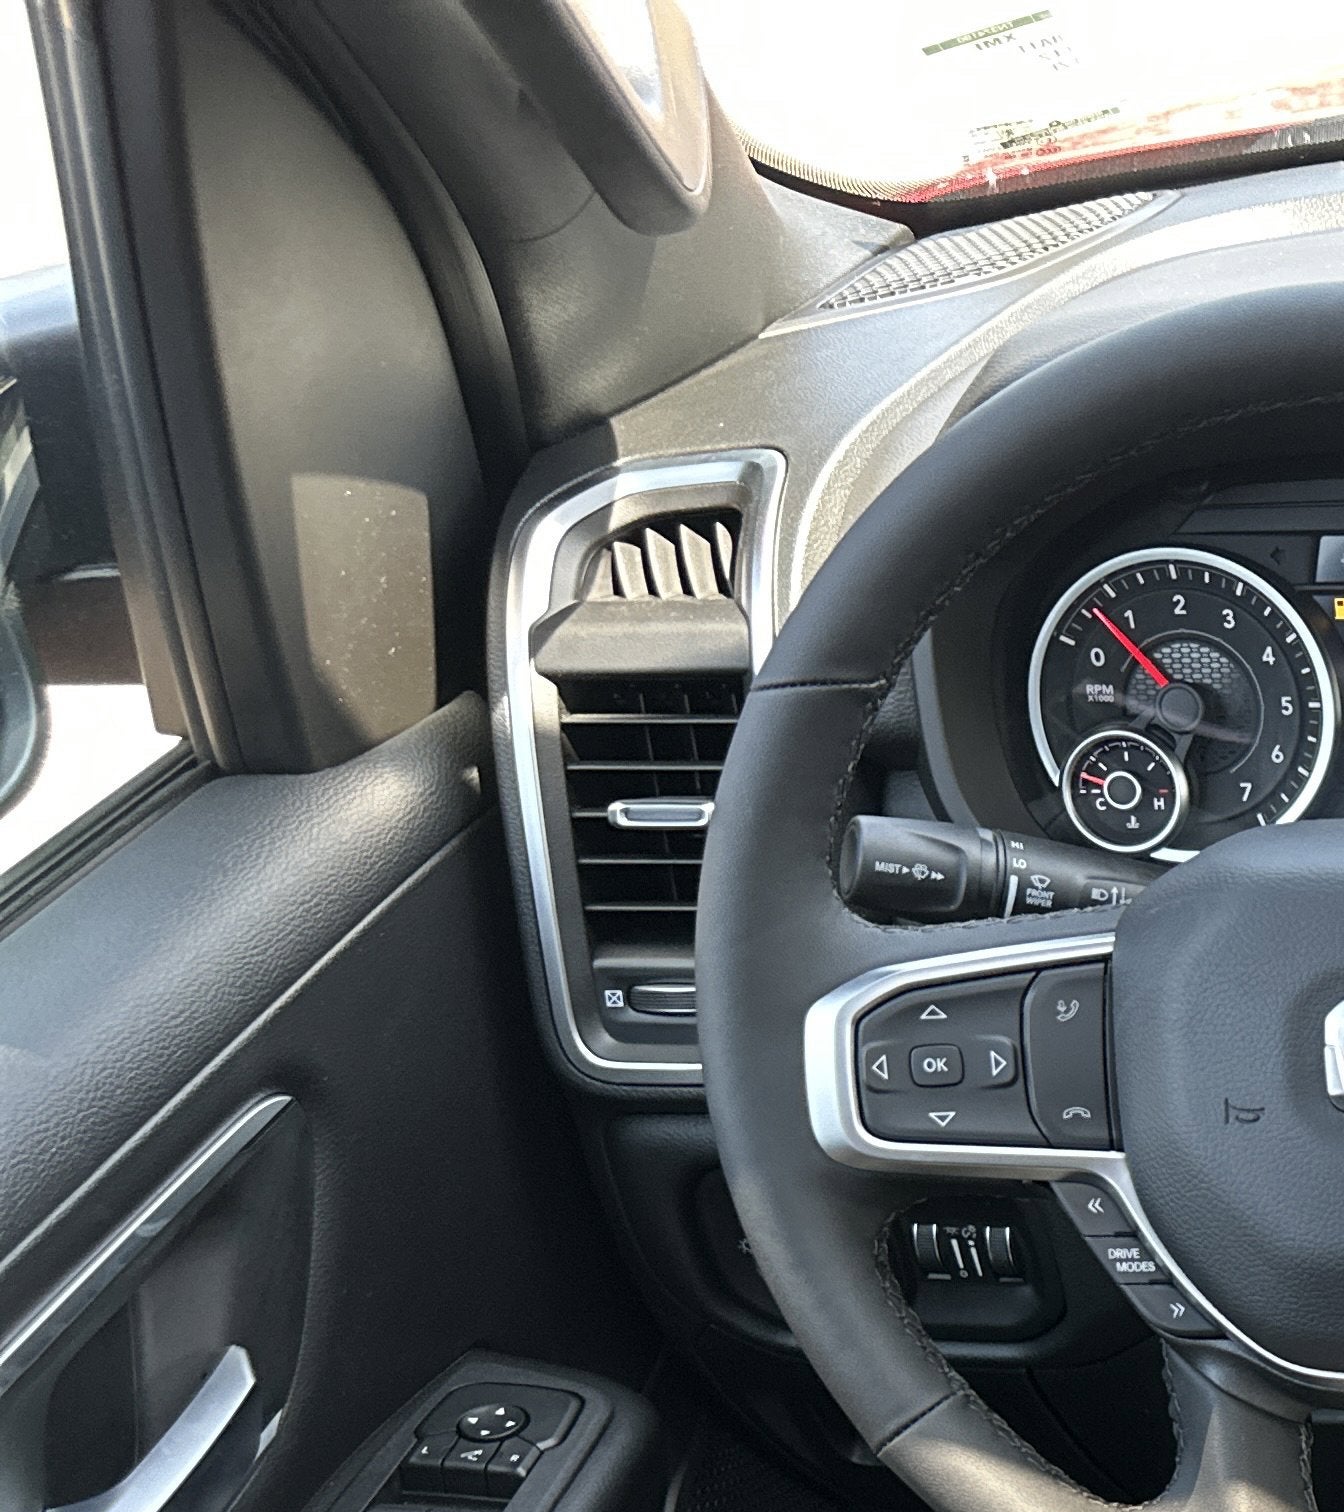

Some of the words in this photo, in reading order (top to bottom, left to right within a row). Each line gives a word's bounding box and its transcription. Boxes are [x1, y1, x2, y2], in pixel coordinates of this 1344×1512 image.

[1172, 594, 1187, 615] 2
[1124, 609, 1136, 629] 1
[1222, 608, 1236, 630] 3
[1090, 647, 1105, 667] 0
[1261, 646, 1275, 666] 4
[1086, 684, 1114, 696] RPM
[1281, 696, 1294, 716] 5
[1271, 744, 1285, 764] 6
[1239, 782, 1253, 802] 7
[1095, 798, 1107, 811] C
[1154, 798, 1165, 810] H
[875, 861, 903, 875] MIST
[1012, 858, 1027, 869] LO
[1026, 888, 1055, 901] FRONT
[922, 1058, 948, 1073] OK
[1107, 1248, 1140, 1261] DRIVE
[1116, 1260, 1156, 1273] MODES
